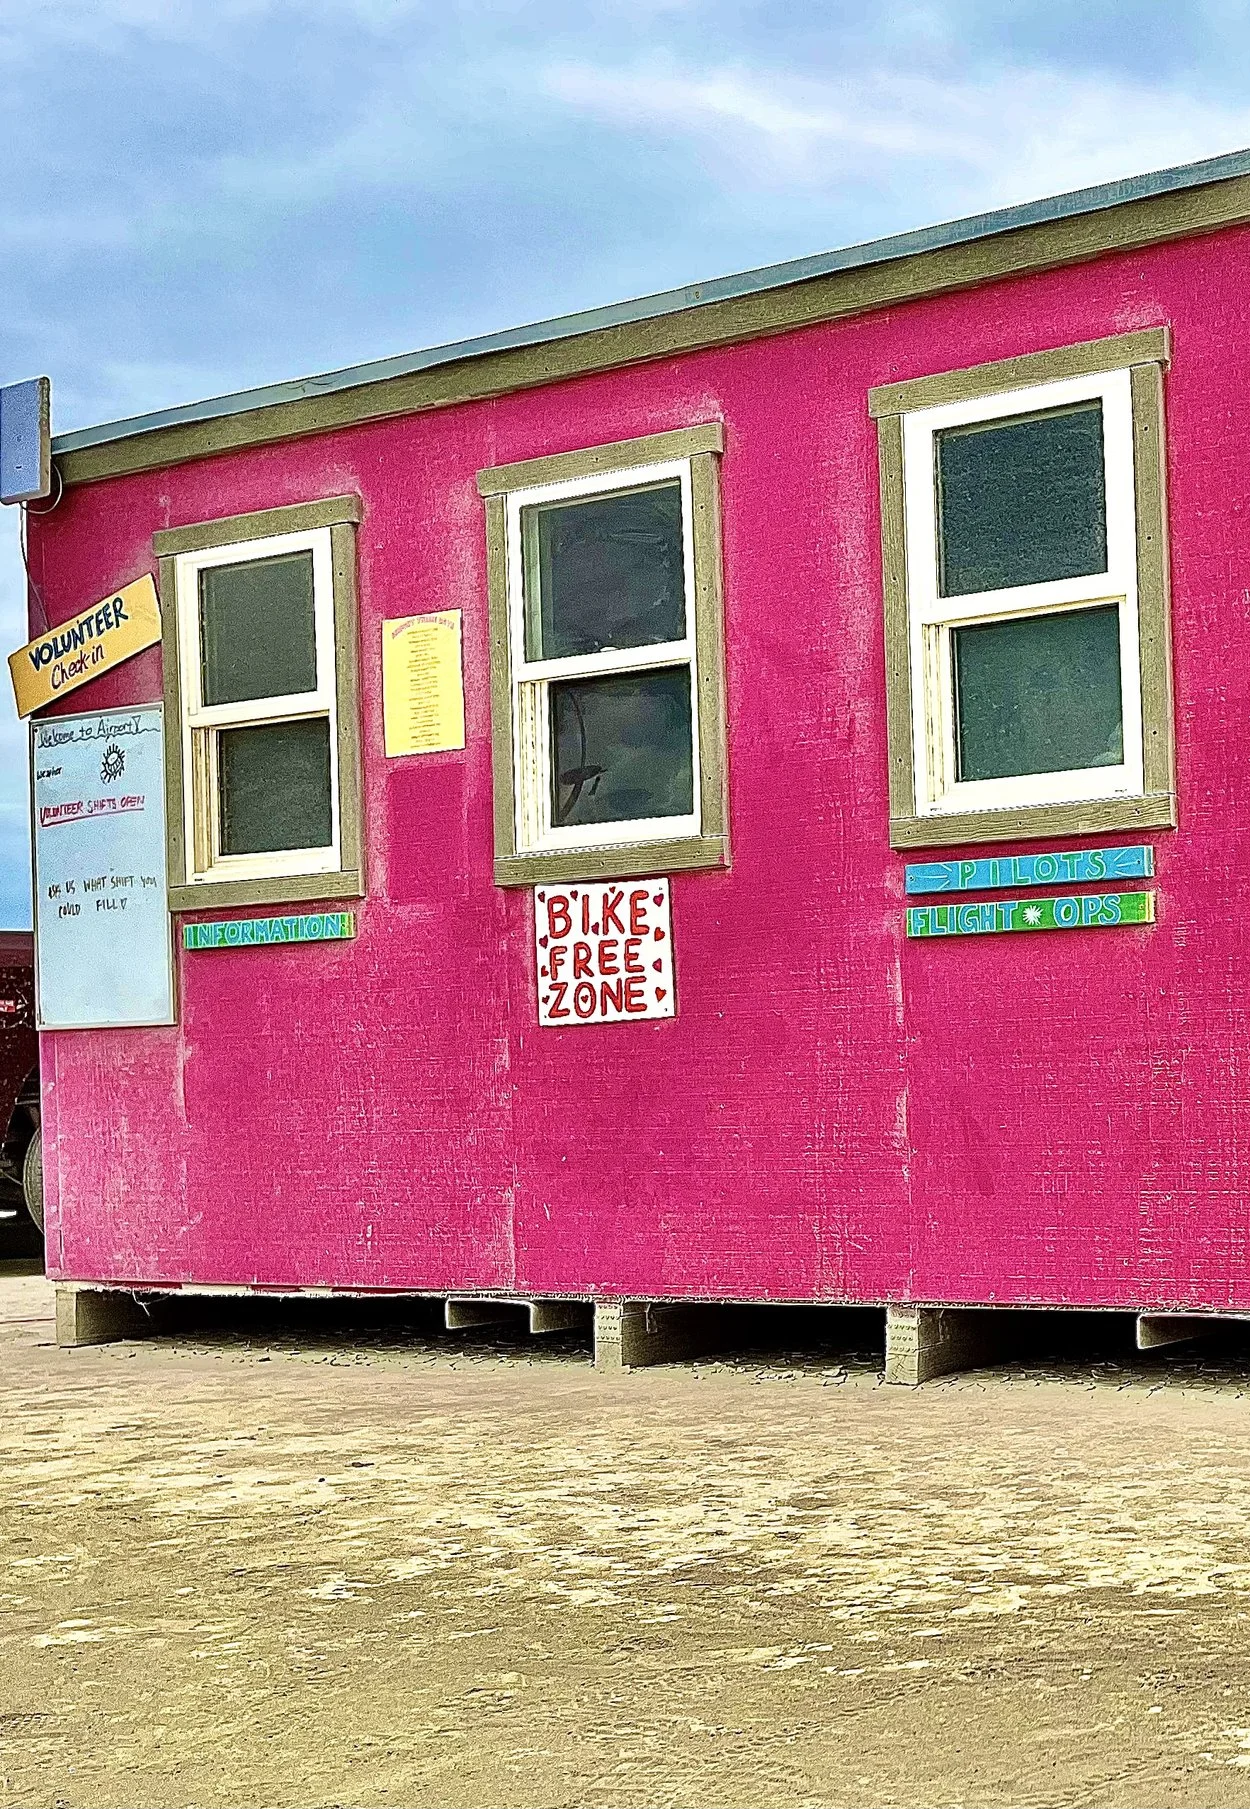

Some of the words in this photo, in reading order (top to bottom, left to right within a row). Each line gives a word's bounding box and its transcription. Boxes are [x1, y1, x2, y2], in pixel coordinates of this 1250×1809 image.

[29, 597, 128, 671] VOLUNTEER
[51, 644, 104, 690] Check-in
[79, 726, 92, 737] to
[87, 798, 117, 814] SHIFTS
[83, 876, 107, 892] WHAT
[111, 876, 134, 889] SHIFT
[959, 851, 1106, 888] PILOTS
[186, 914, 341, 949] INFORMATION
[547, 890, 650, 939] BIKE
[910, 901, 1018, 935] FLIGHT
[1054, 895, 1121, 927] OPS
[549, 938, 645, 981] FREE
[548, 976, 647, 1018] ZONE
